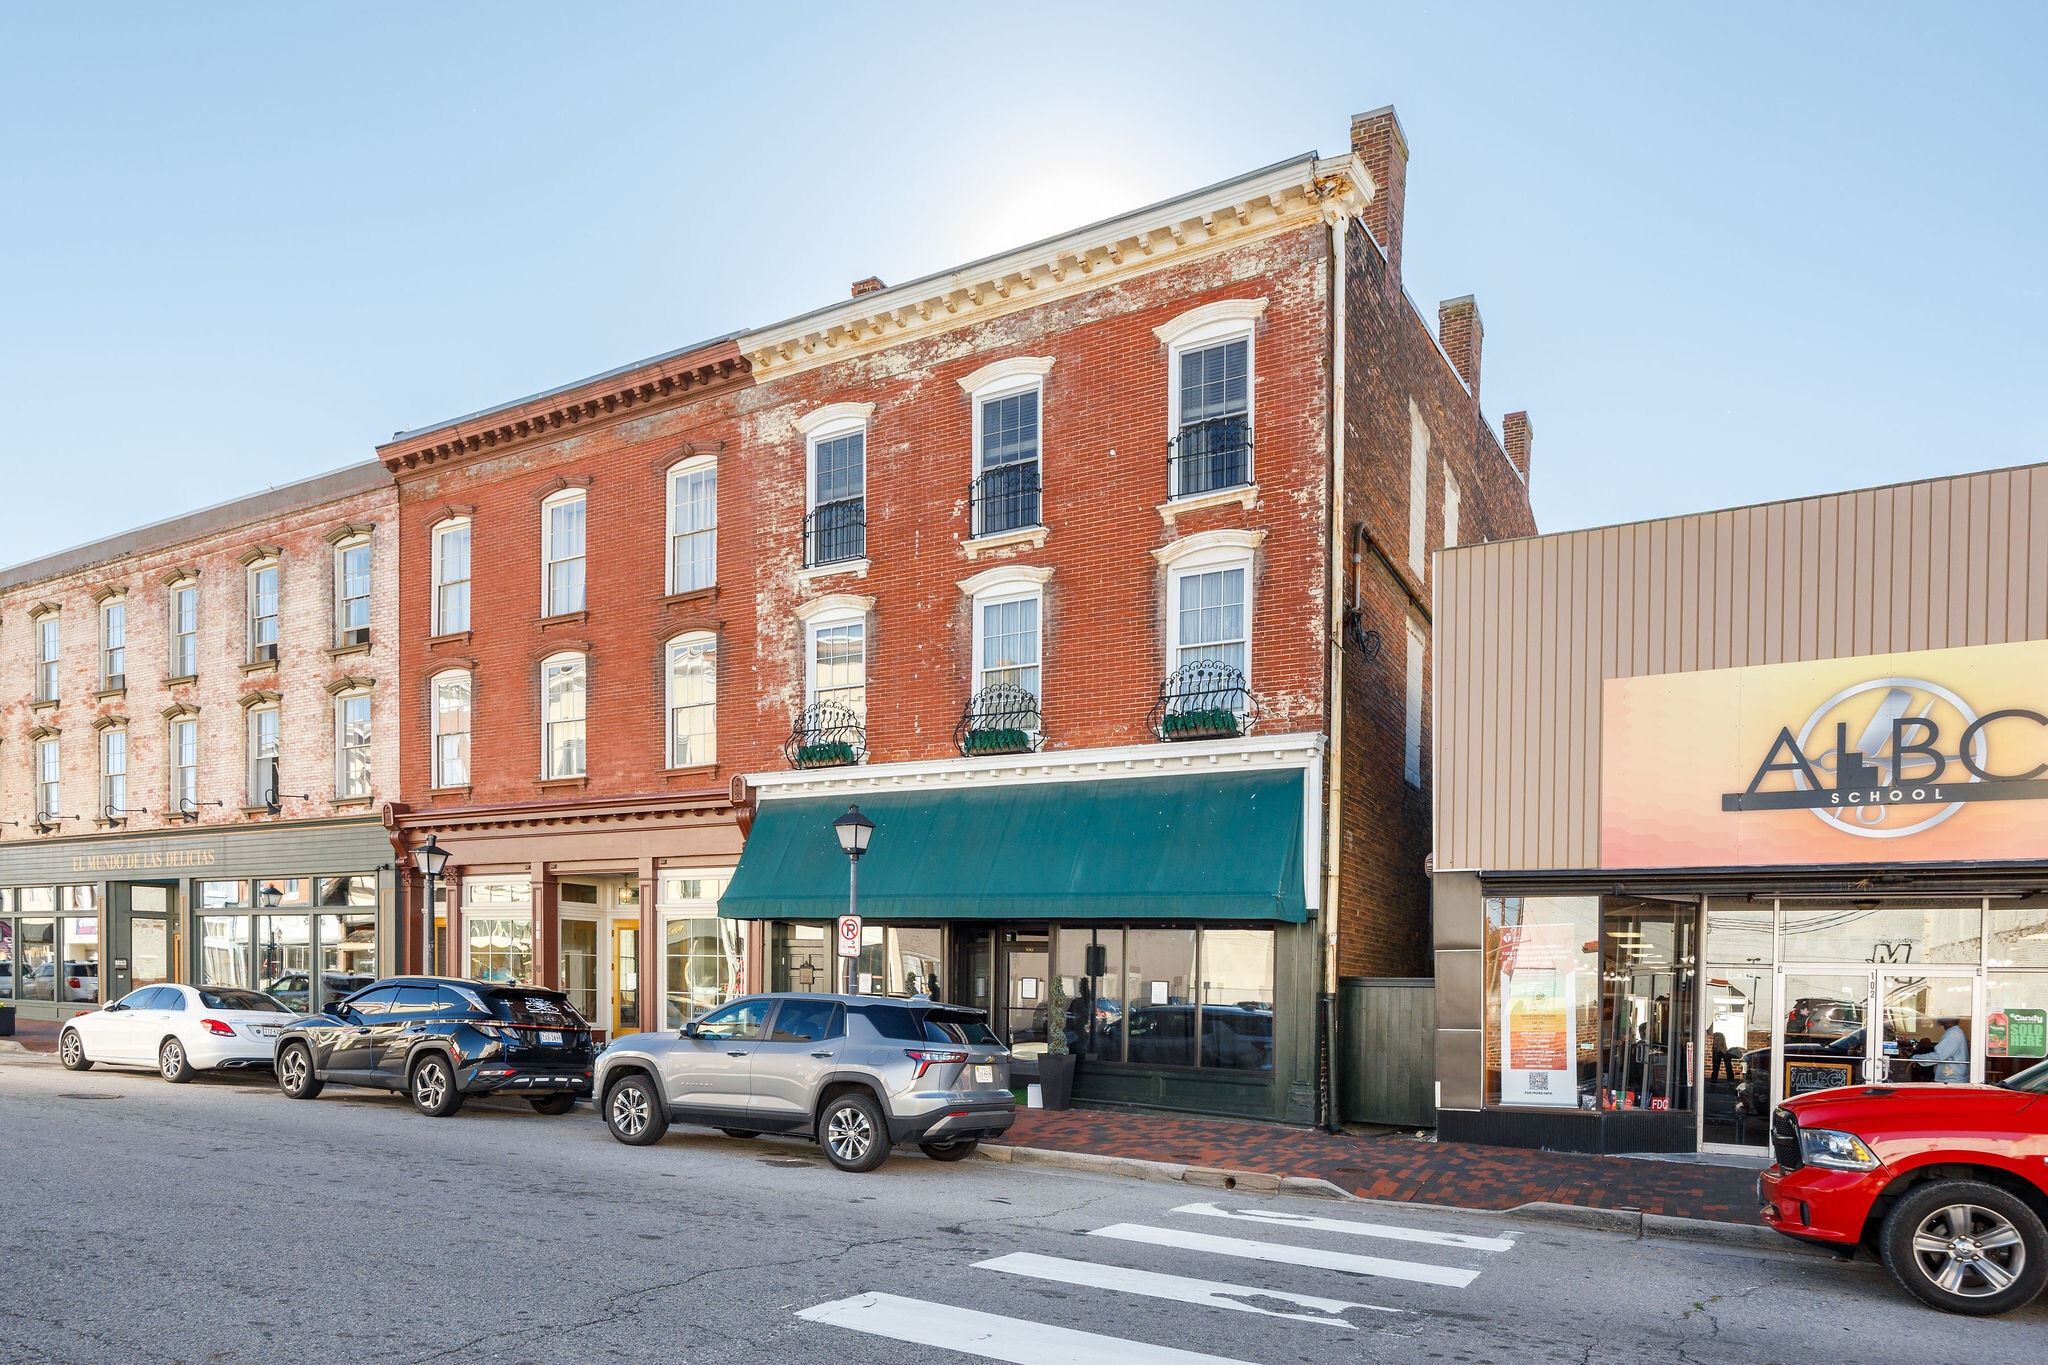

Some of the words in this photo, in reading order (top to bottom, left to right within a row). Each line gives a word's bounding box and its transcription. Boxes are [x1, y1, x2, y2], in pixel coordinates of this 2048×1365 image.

[1746, 709, 2048, 794] ALBC
[1831, 788, 1943, 804] SCHOOL
[72, 856, 85, 872] EL
[87, 854, 124, 871] MUNDO
[127, 853, 140, 869] DE
[143, 851, 163, 869] LAS
[166, 849, 215, 867] DELICIAS
[2010, 1024, 2043, 1036] SOLD
[2010, 1035, 2043, 1047] HERE
